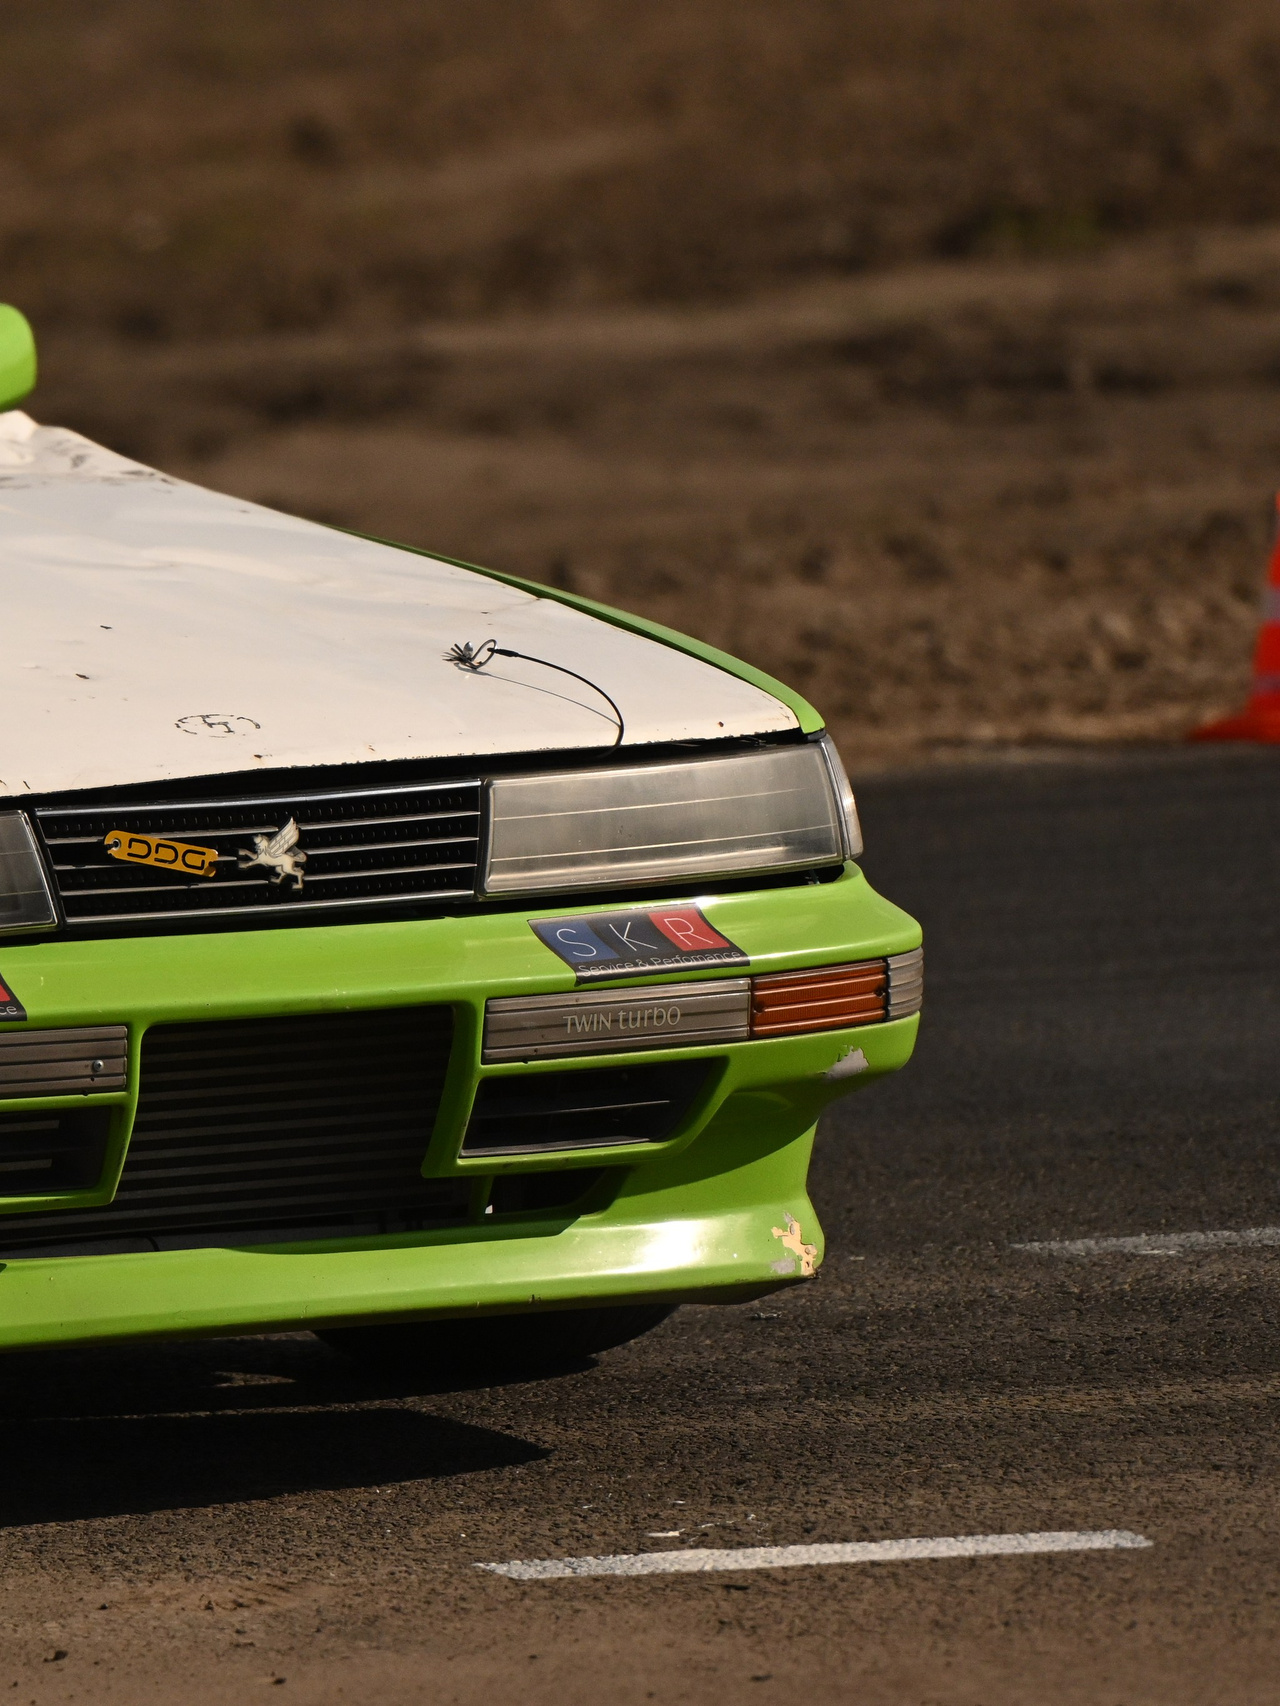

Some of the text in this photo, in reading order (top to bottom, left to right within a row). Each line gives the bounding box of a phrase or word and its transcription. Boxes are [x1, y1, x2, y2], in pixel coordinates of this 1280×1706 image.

[555, 916, 714, 958] SKR
[578, 962, 634, 977] Service
[651, 951, 741, 968] Perfomance
[562, 1005, 682, 1034] TWIN turbo
